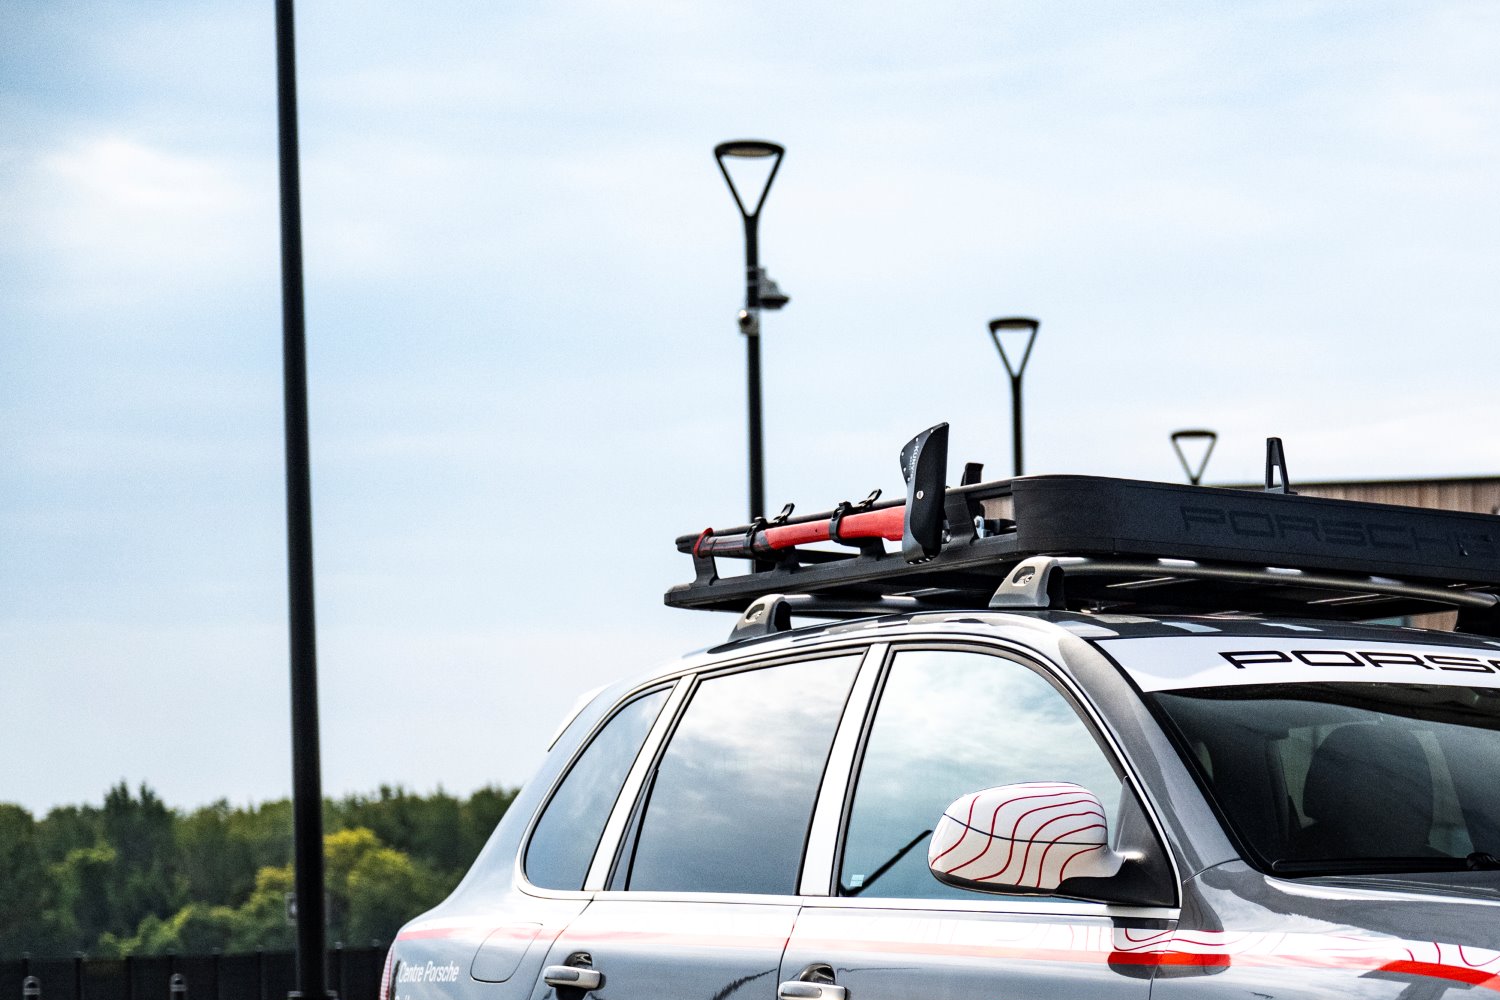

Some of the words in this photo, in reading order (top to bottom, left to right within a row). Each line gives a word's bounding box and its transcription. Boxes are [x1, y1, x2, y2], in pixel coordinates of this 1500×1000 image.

[1180, 505, 1496, 557] PORSCHE
[398, 962, 424, 982] Centre
[423, 960, 460, 982] Porsche
